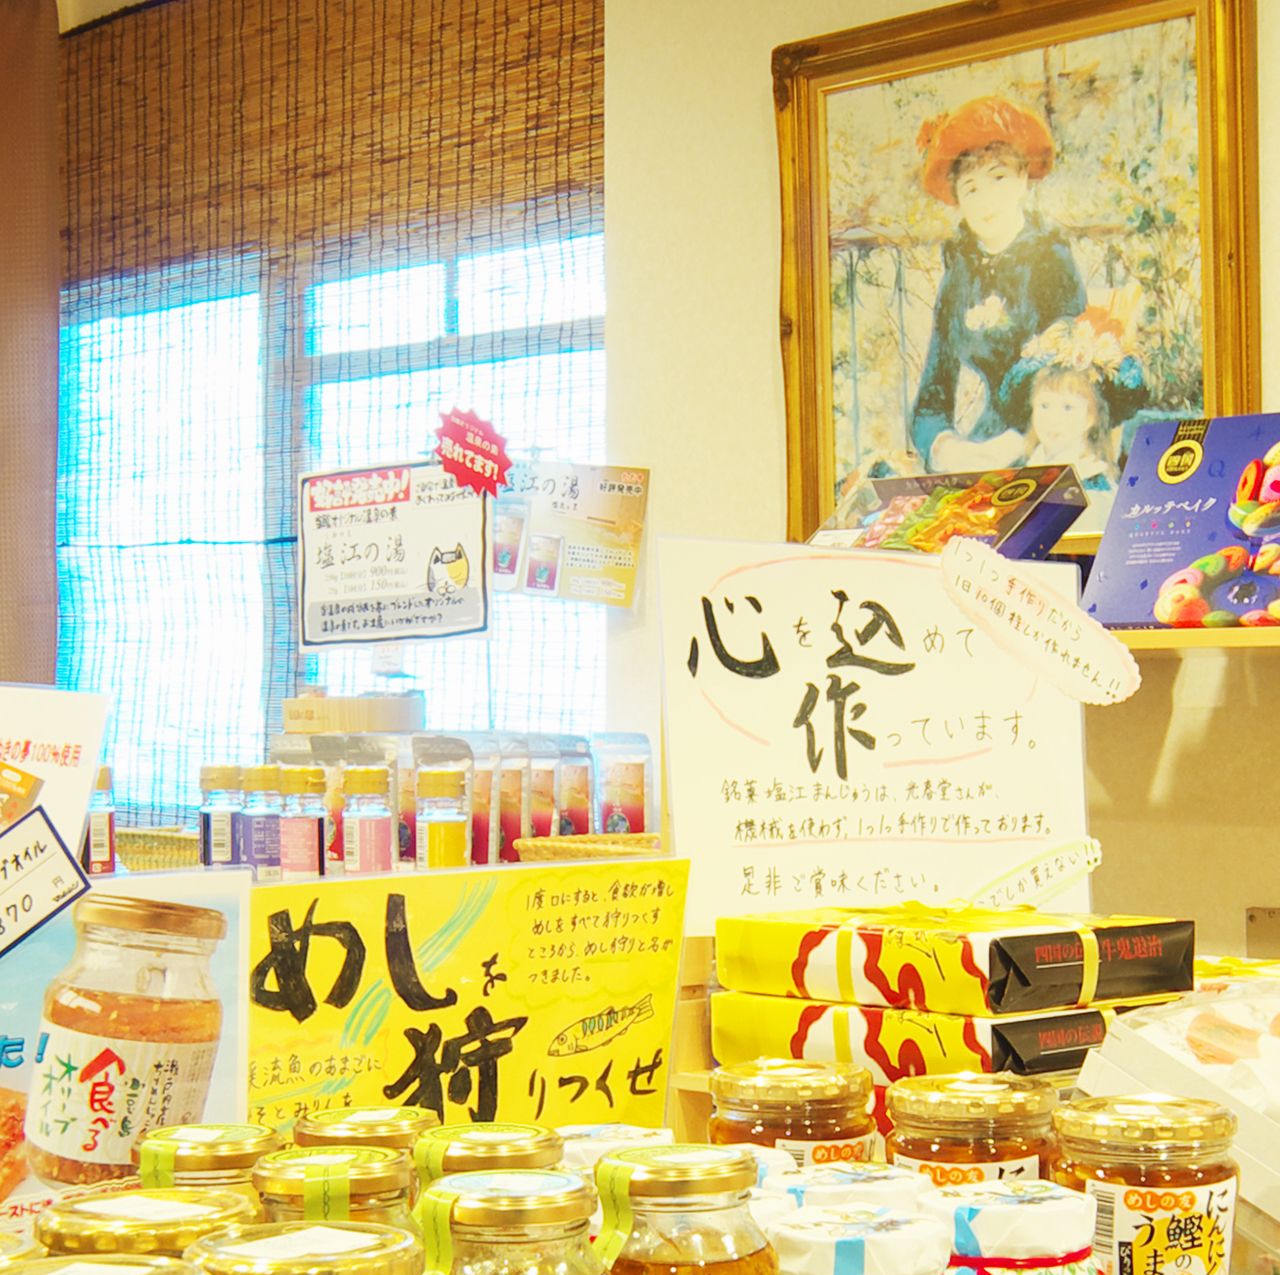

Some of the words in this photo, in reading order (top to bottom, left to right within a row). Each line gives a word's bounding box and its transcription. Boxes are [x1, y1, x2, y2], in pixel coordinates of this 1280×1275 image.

[316, 534, 407, 570] 塩江の湯
[687, 589, 976, 680] 心を込めて
[792, 673, 1037, 781] 作っています。
[739, 865, 941, 899] 是非ご賞味ください。
[251, 892, 509, 1025] めしを
[527, 965, 592, 986] つきました。
[40, 1064, 61, 1138] オイル
[53, 1052, 80, 1136] オリーブ
[77, 1046, 127, 1153] 食べる
